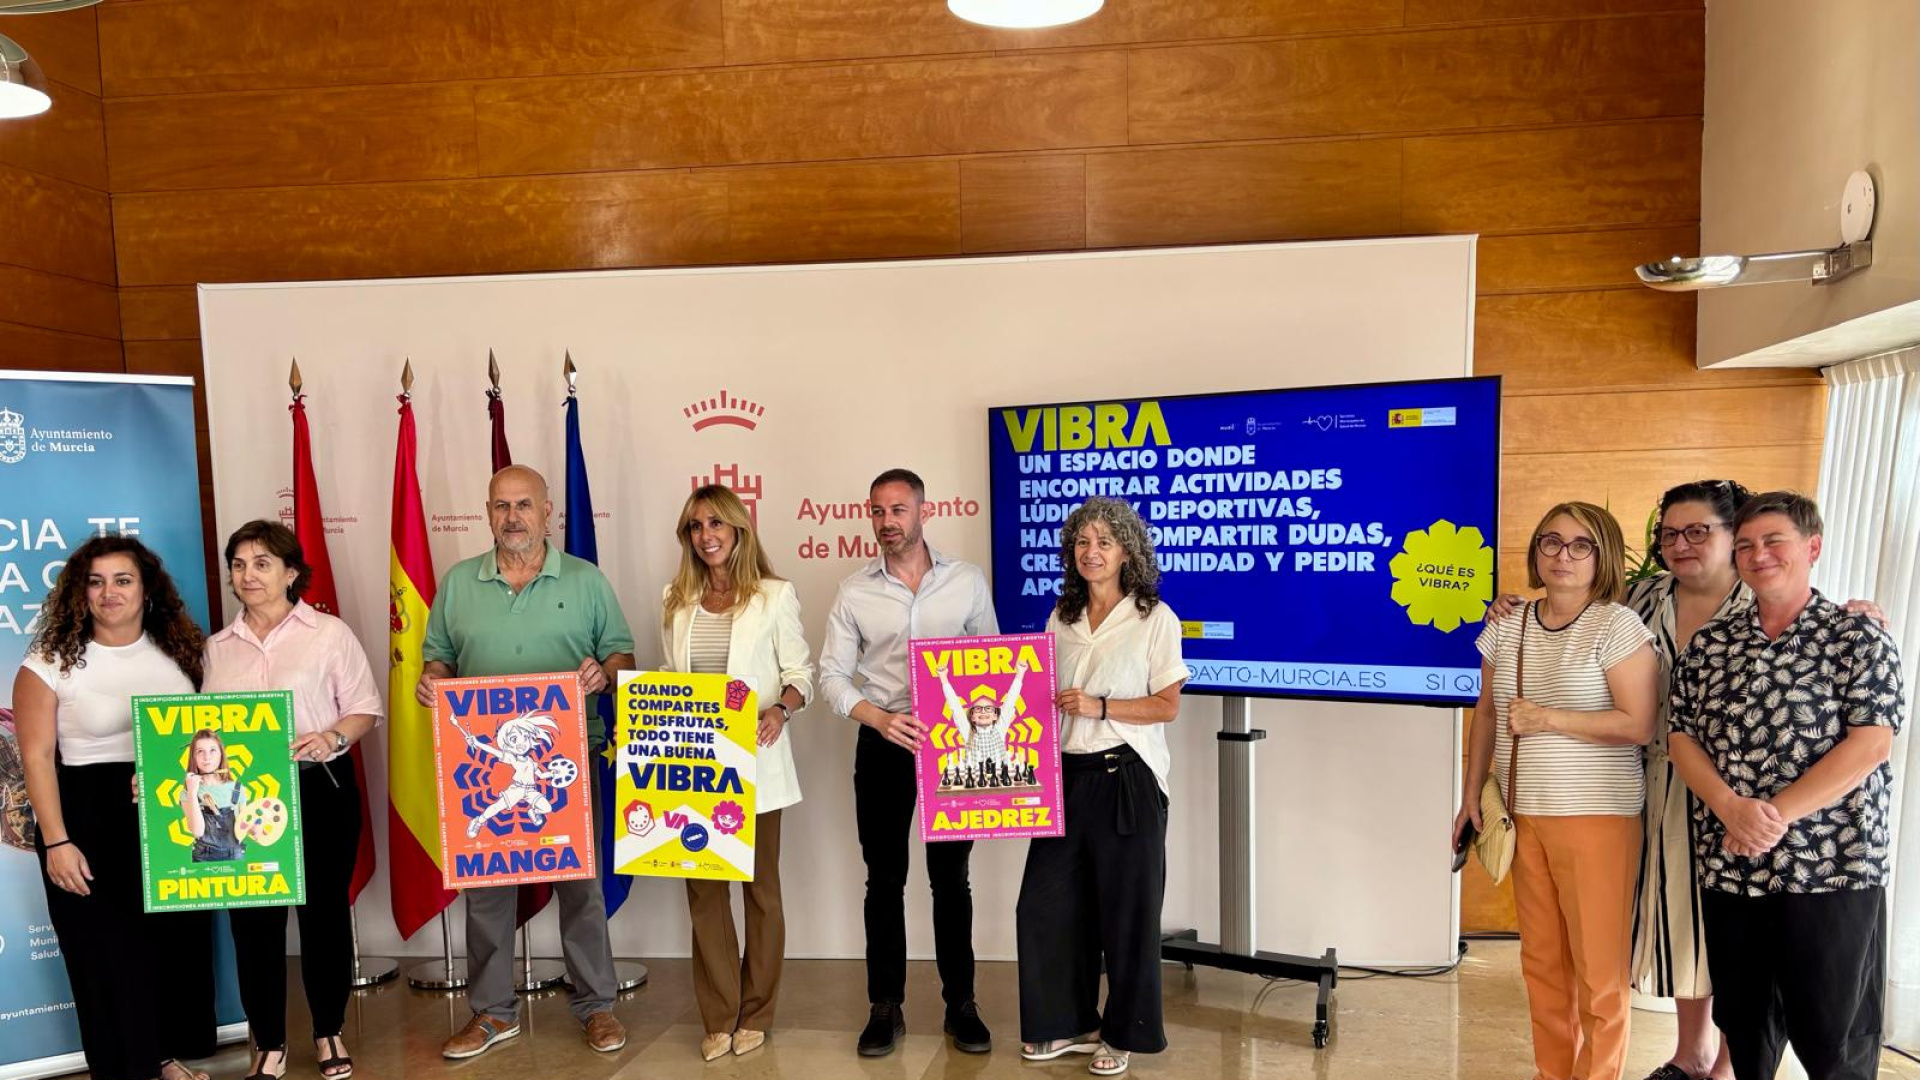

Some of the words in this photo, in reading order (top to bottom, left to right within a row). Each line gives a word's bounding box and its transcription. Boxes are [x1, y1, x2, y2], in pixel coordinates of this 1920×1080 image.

[30, 428, 112, 440] Ayuntamiento
[1002, 401, 1172, 452] VIBRA
[31, 442, 46, 452] de
[50, 442, 95, 452] Murcia
[1020, 454, 1051, 474] UN
[1060, 449, 1158, 472] ESPACIO
[1167, 444, 1256, 468] DONDE
[1020, 476, 1160, 498] ENCONTRAR
[1170, 468, 1342, 494] ACTIVIDADES
[432, 514, 482, 523] Ayuntamiento
[1150, 497, 1320, 520] DEPORTIVAS,
[1289, 522, 1392, 547] DUDAS,
[798, 536, 829, 559] de
[1157, 552, 1254, 572] UNIDAD
[1265, 552, 1284, 572] Y
[1295, 551, 1375, 572] PEDIR
[1416, 563, 1453, 576] ¿QUÉ
[1458, 567, 1475, 577] ES
[1419, 577, 1470, 591] VIBRA?
[922, 645, 1044, 678] VIBRA
[628, 684, 693, 697] CUANDO
[1426, 674, 1445, 690] SI
[445, 684, 571, 716] VIBRA
[628, 699, 720, 713] COMPARTES
[147, 702, 281, 736] VIBRA
[628, 714, 639, 725] Y
[642, 715, 729, 731] DISFRUTAS,
[628, 729, 672, 742] TODO
[673, 731, 714, 744] TIENE
[628, 744, 660, 757] UNA
[664, 746, 716, 760] BUENA
[628, 762, 744, 794] VIBRA
[932, 807, 1052, 830] AJEDREZ
[456, 846, 582, 877] MANGA
[158, 873, 290, 900] PINTURA
[30, 948, 60, 960] Salud
